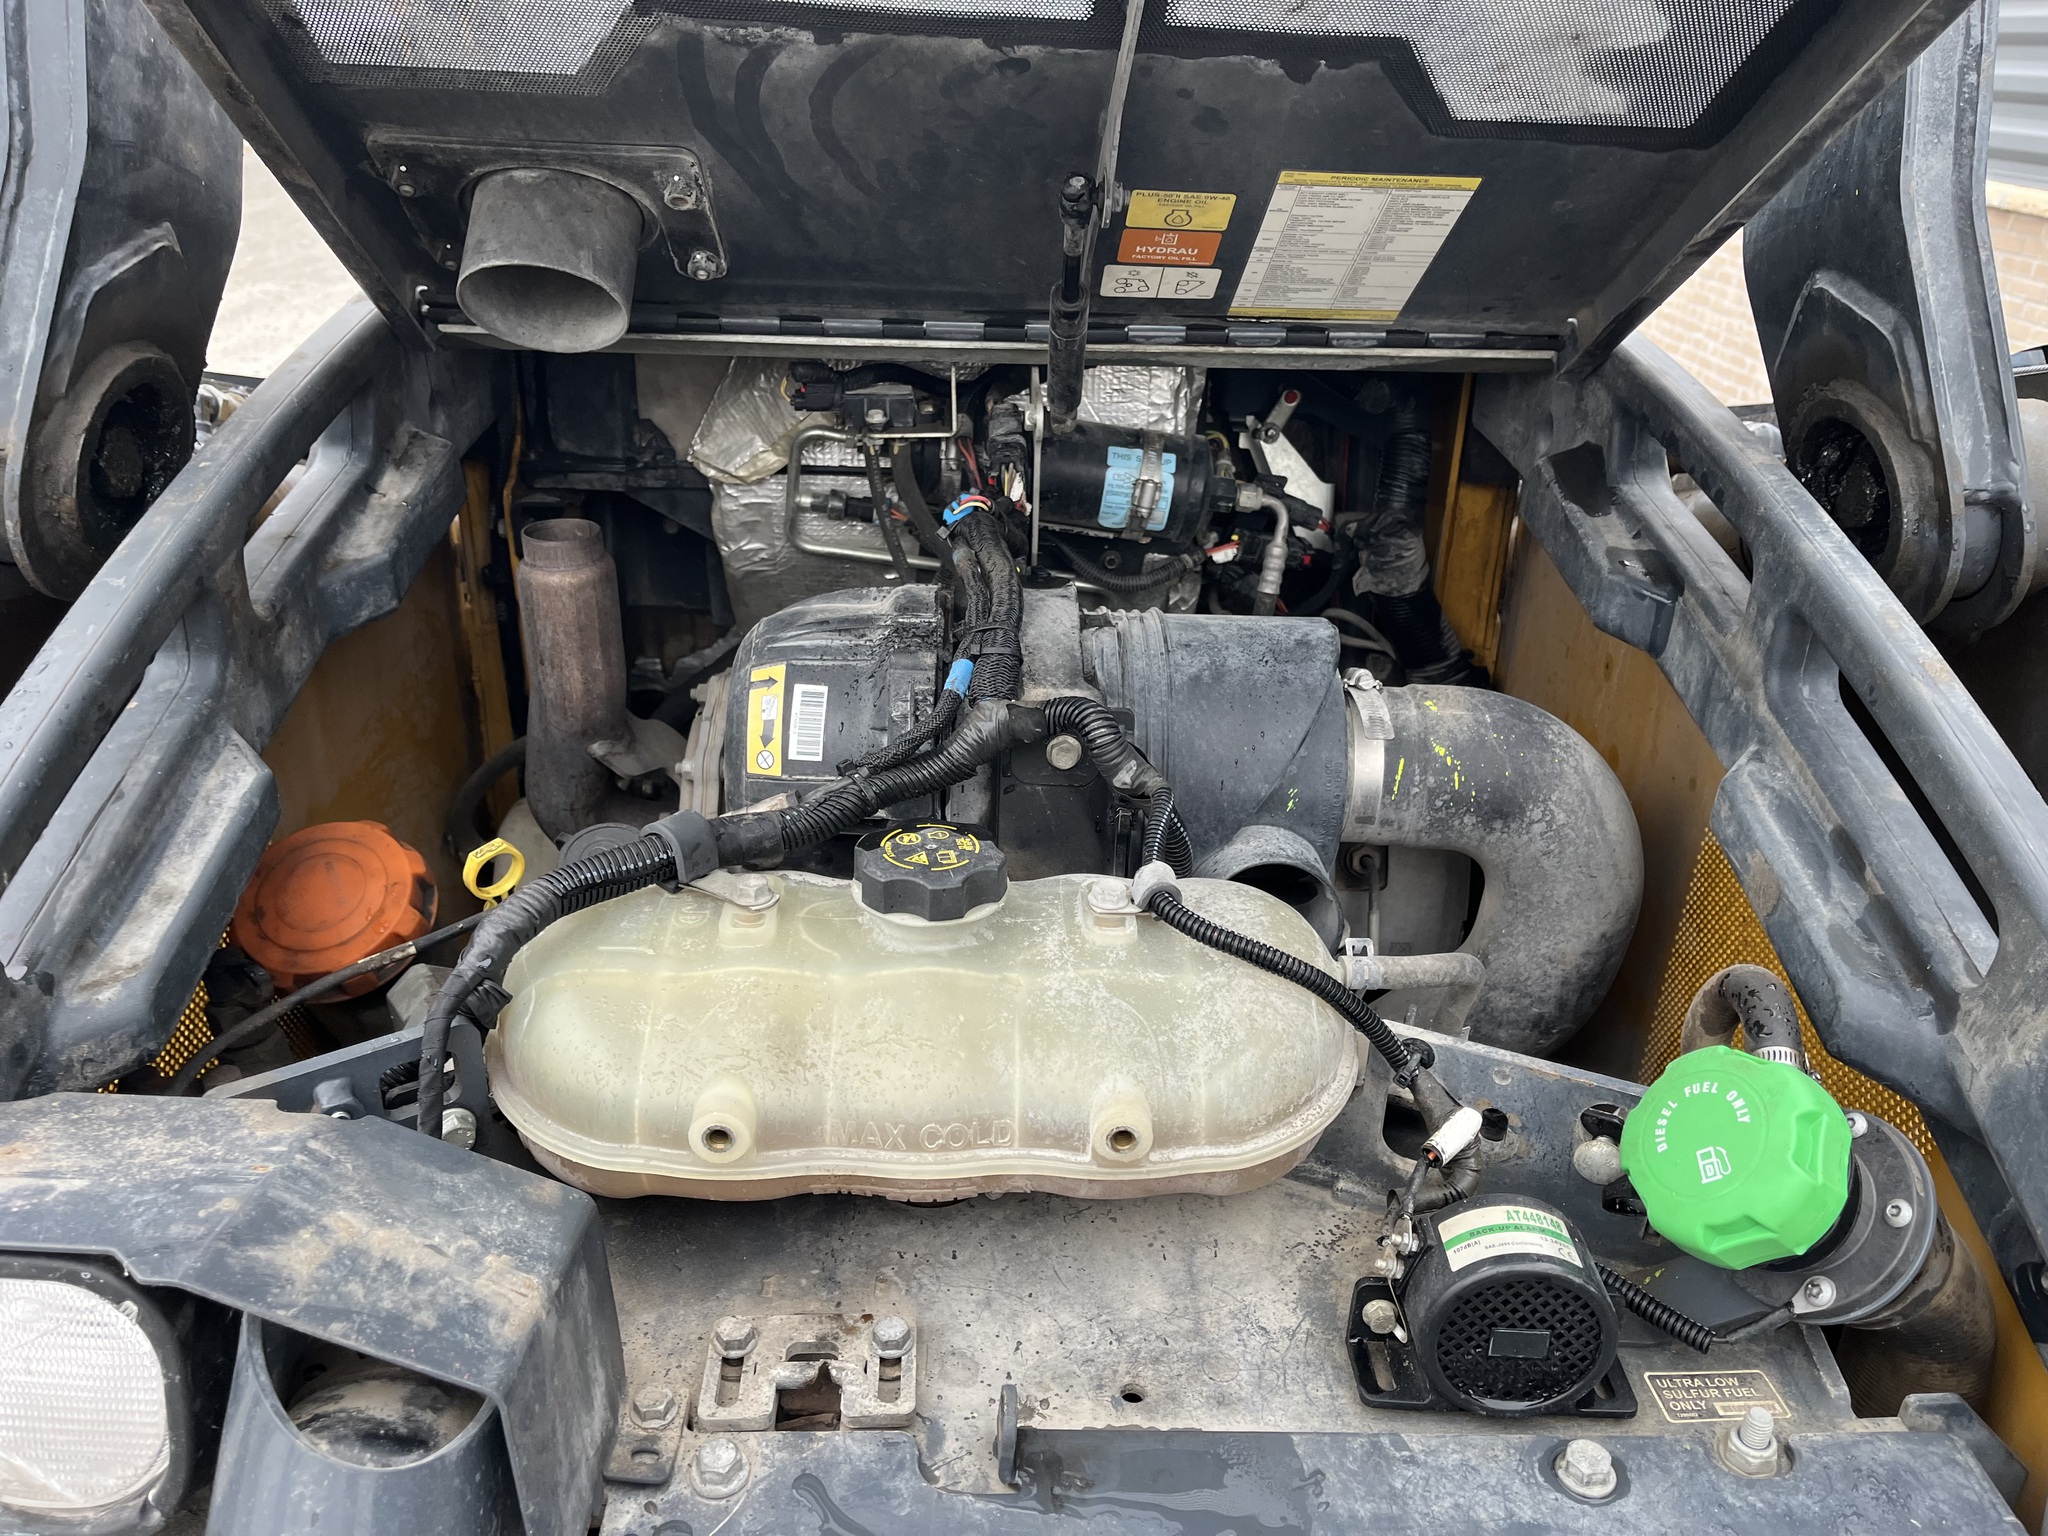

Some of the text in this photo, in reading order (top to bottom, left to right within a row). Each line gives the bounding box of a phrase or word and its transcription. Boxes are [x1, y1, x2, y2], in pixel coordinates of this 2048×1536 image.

[1136, 246, 1198, 256] HYDRAU
[1112, 452, 1131, 461] THIS
[1655, 1081, 1750, 1153] DIESEL FUEL ONLY
[827, 1118, 1017, 1151] MAX COLD
[1506, 1209, 1564, 1233] AT448148
[1469, 1225, 1546, 1237] BACK-UP ALARM
[1453, 1239, 1481, 1255] 107dB(A)
[1656, 1377, 1739, 1388] ULTRA LOW
[1662, 1387, 1762, 1400] SULFUR FUEL
[1669, 1400, 1707, 1411] ONLY
